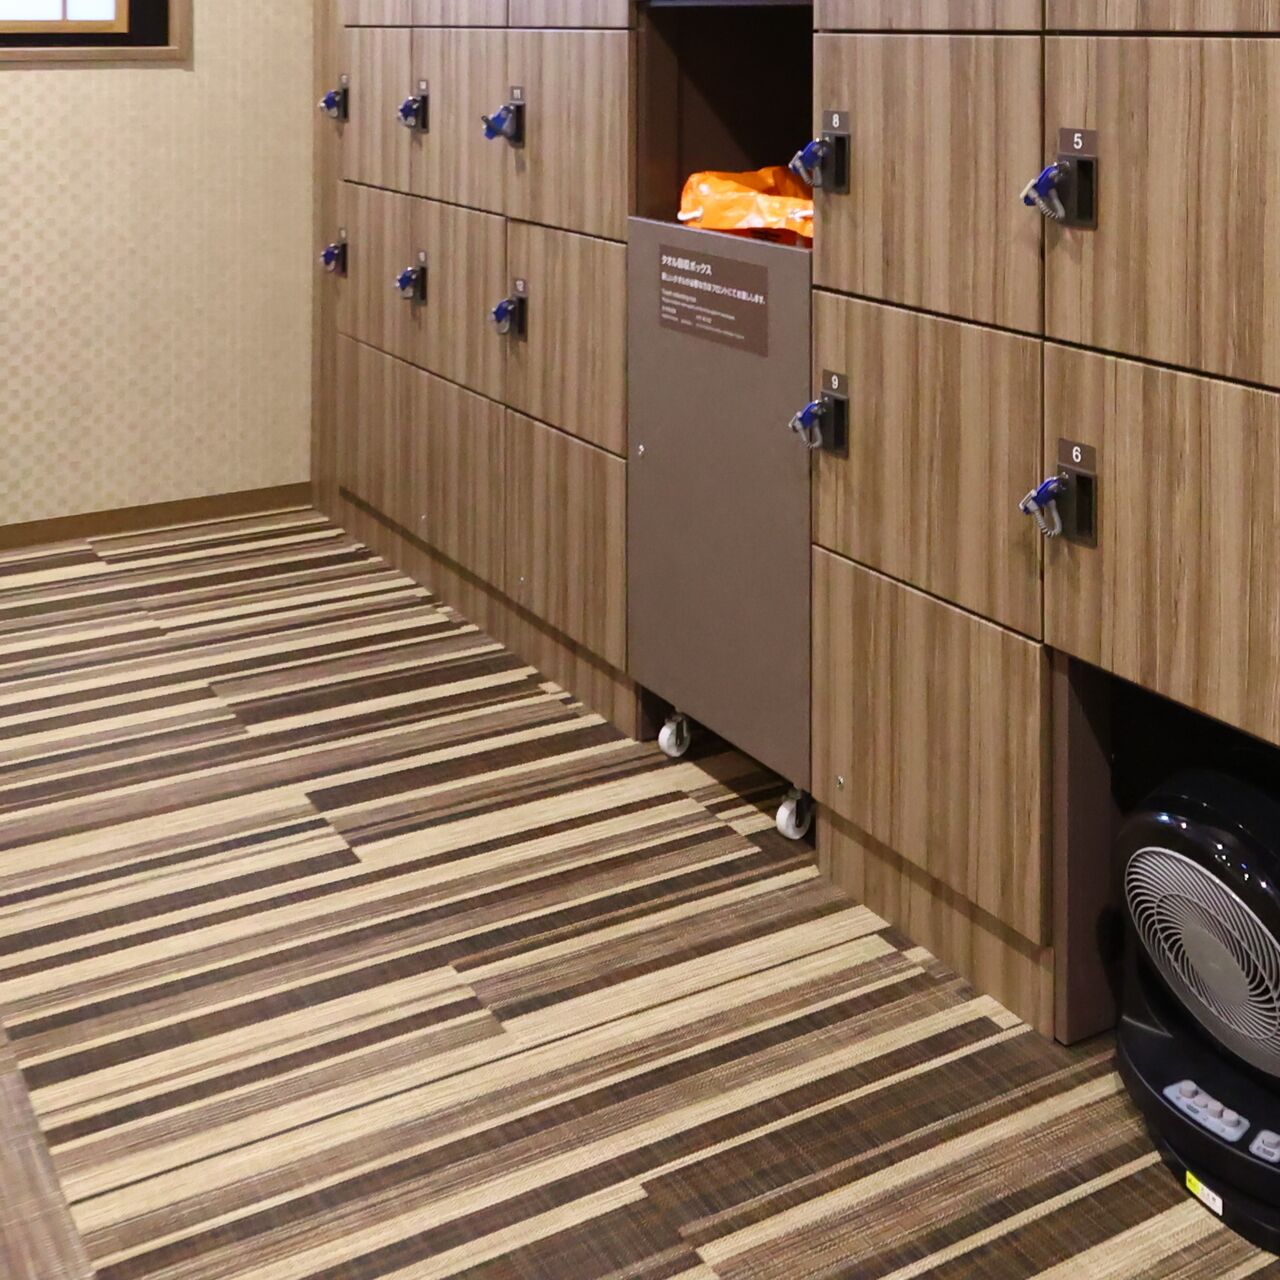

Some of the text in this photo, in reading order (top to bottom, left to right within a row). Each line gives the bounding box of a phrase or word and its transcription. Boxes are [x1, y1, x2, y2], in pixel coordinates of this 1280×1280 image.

[832, 113, 839, 127] 8
[1073, 133, 1082, 149] 5
[831, 374, 838, 389] 9
[1072, 446, 1081, 462] 6
